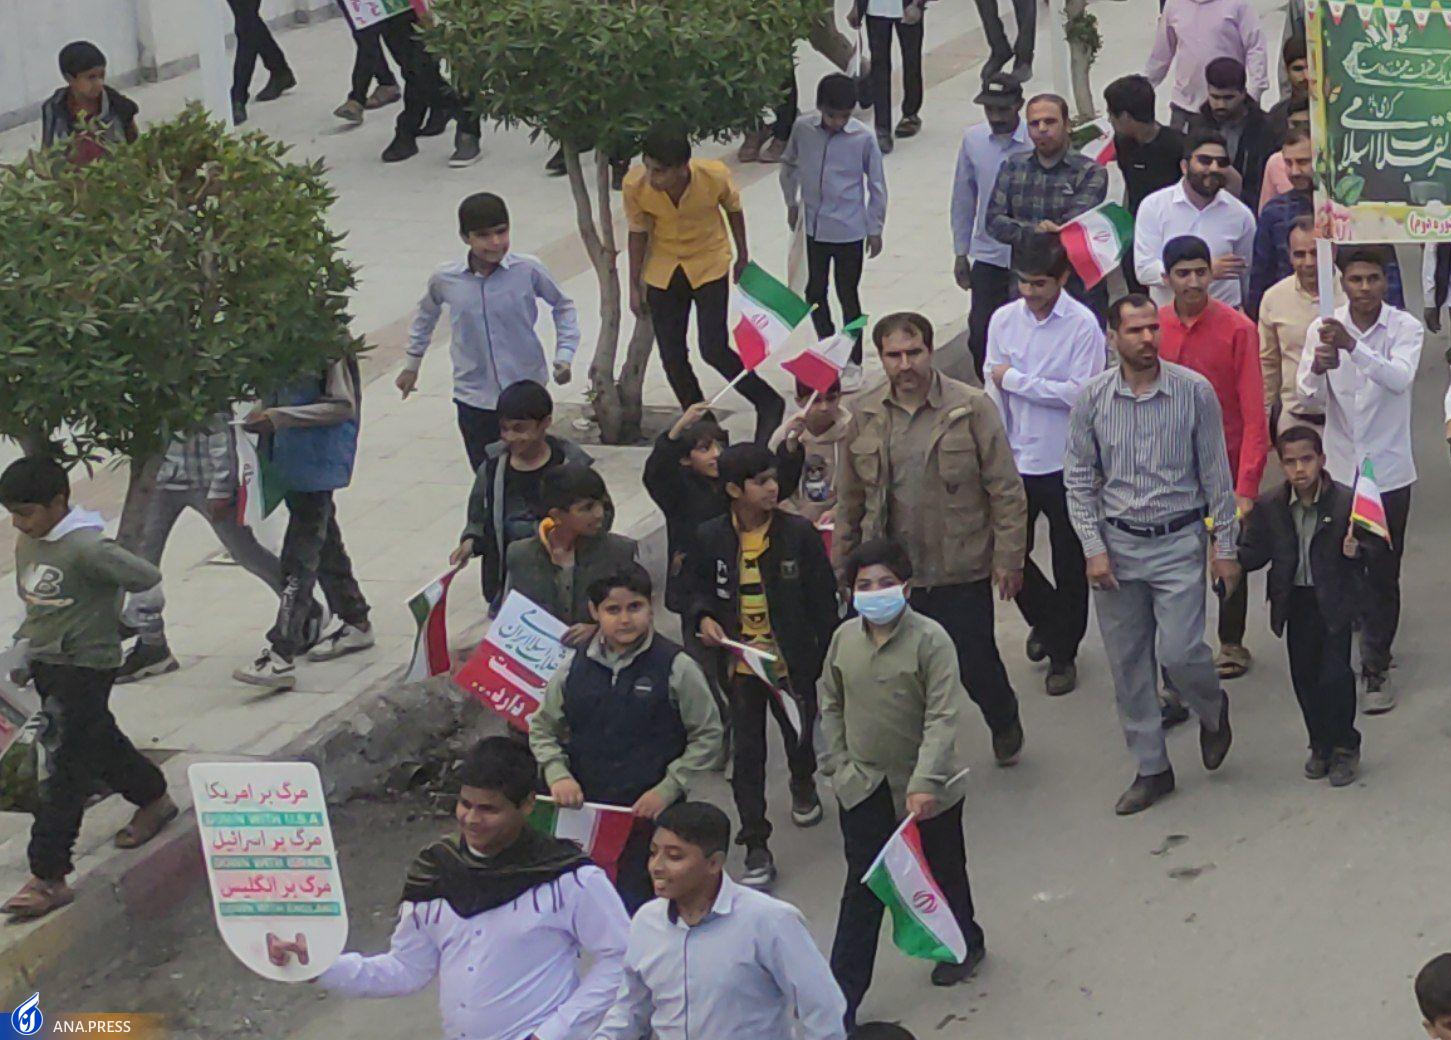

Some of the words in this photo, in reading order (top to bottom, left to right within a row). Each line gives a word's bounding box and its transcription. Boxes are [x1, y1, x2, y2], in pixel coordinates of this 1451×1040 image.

[1338, 96, 1429, 170] اسلامی
[498, 624, 532, 650] ایران
[205, 781, 253, 804] امریکا
[259, 790, 272, 805] بر
[275, 782, 309, 804] مرگ
[212, 829, 267, 851] اسرائیل
[270, 836, 286, 851] بر
[289, 828, 322, 851] مرگ
[219, 875, 277, 898] انگلیس
[281, 883, 297, 898] بر
[299, 875, 332, 897] مرگ
